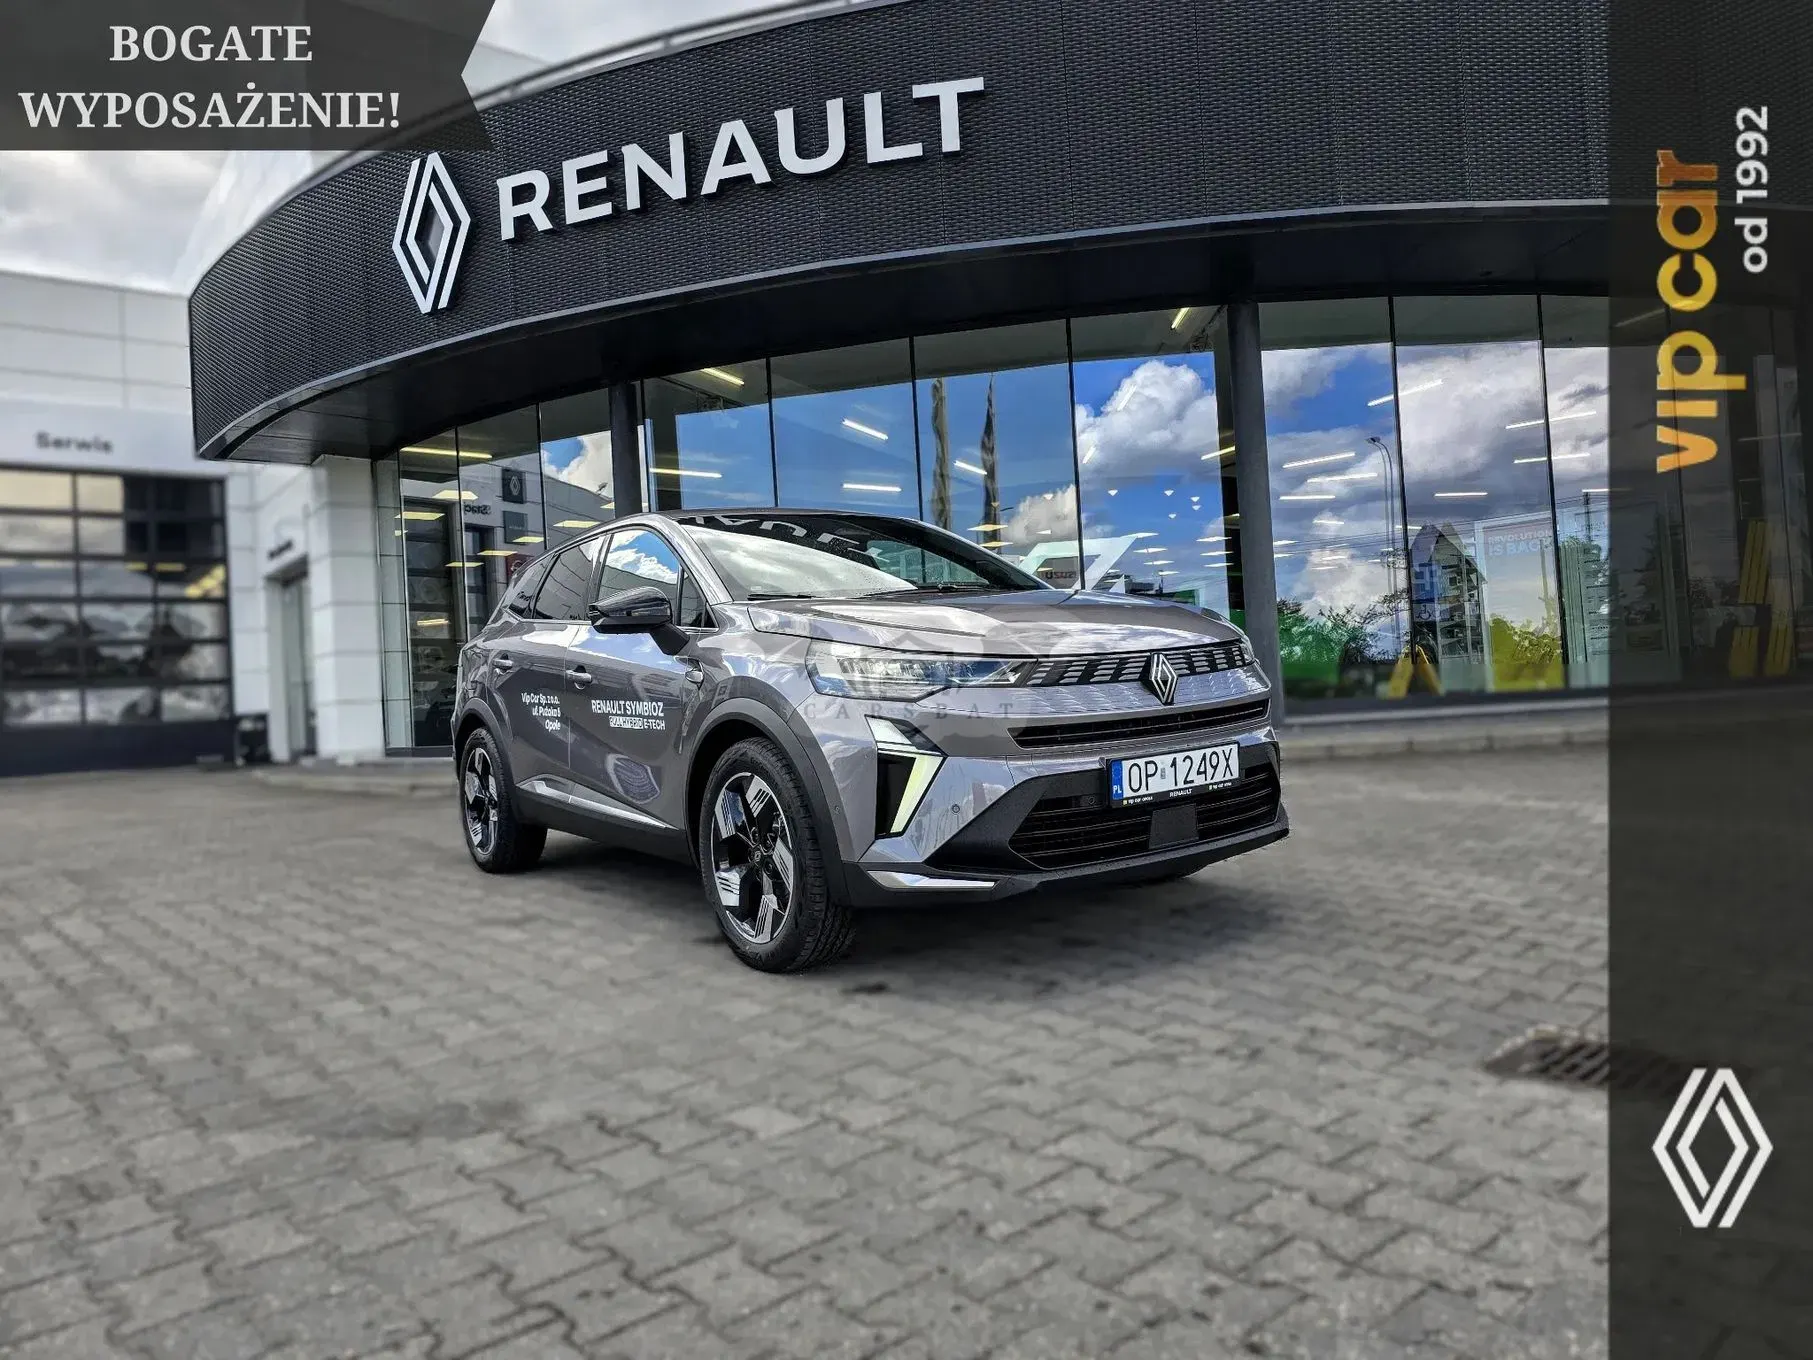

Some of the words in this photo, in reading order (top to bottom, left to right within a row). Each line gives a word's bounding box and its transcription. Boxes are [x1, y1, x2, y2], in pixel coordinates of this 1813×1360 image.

[496, 77, 985, 241] RENAULT
[591, 700, 624, 714] RENAULT
[625, 701, 664, 716] SYMBIOZ
[545, 719, 560, 732] Opole
[643, 719, 665, 730] E-TECH
[1128, 760, 1158, 793] OP
[1170, 748, 1233, 787] 1249X
[1113, 786, 1122, 794] PL
[1169, 788, 1193, 798] RENAULT
